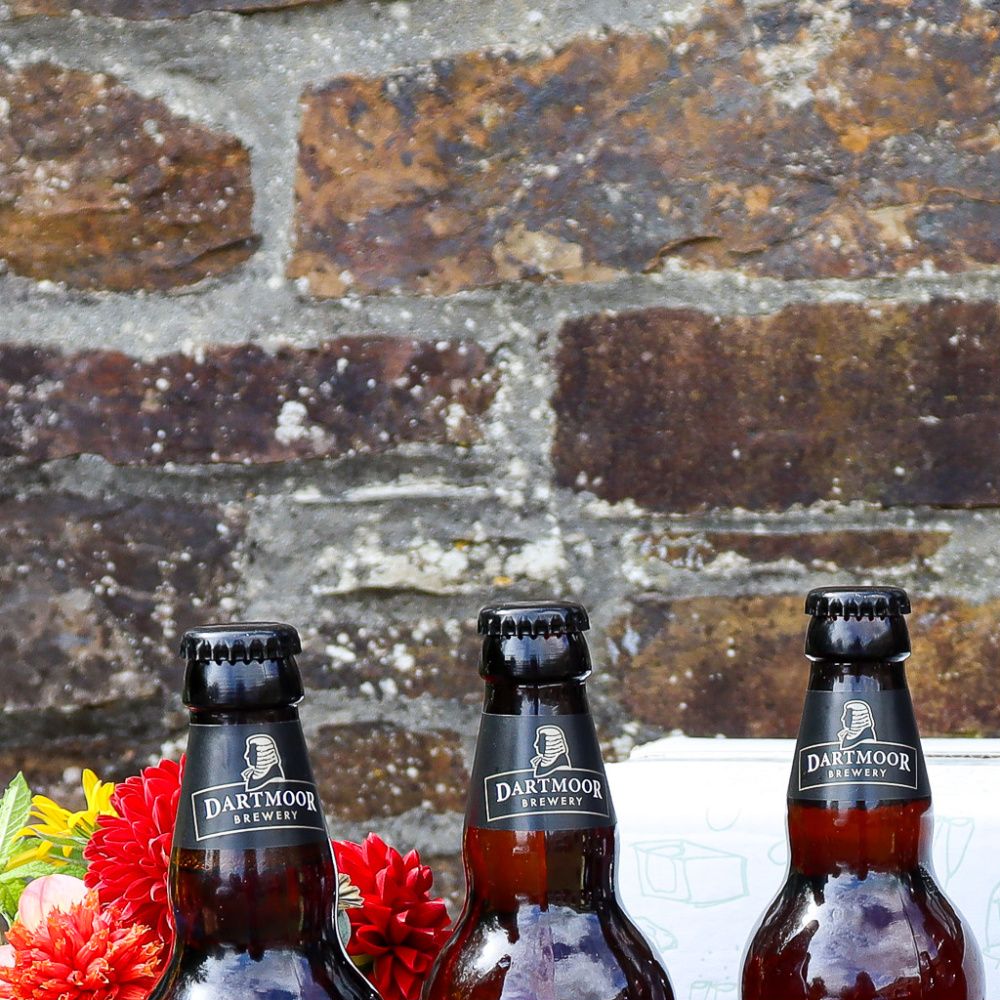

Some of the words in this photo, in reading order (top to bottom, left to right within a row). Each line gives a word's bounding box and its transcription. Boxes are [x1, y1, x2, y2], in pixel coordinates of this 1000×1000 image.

[807, 750, 911, 773] DARTMOOR
[828, 768, 887, 779] BREWERY
[496, 778, 603, 803] DARTMOOR
[204, 790, 317, 820] DARTMOOR
[522, 796, 583, 808] BREWERY
[234, 810, 298, 824] BREWERY
